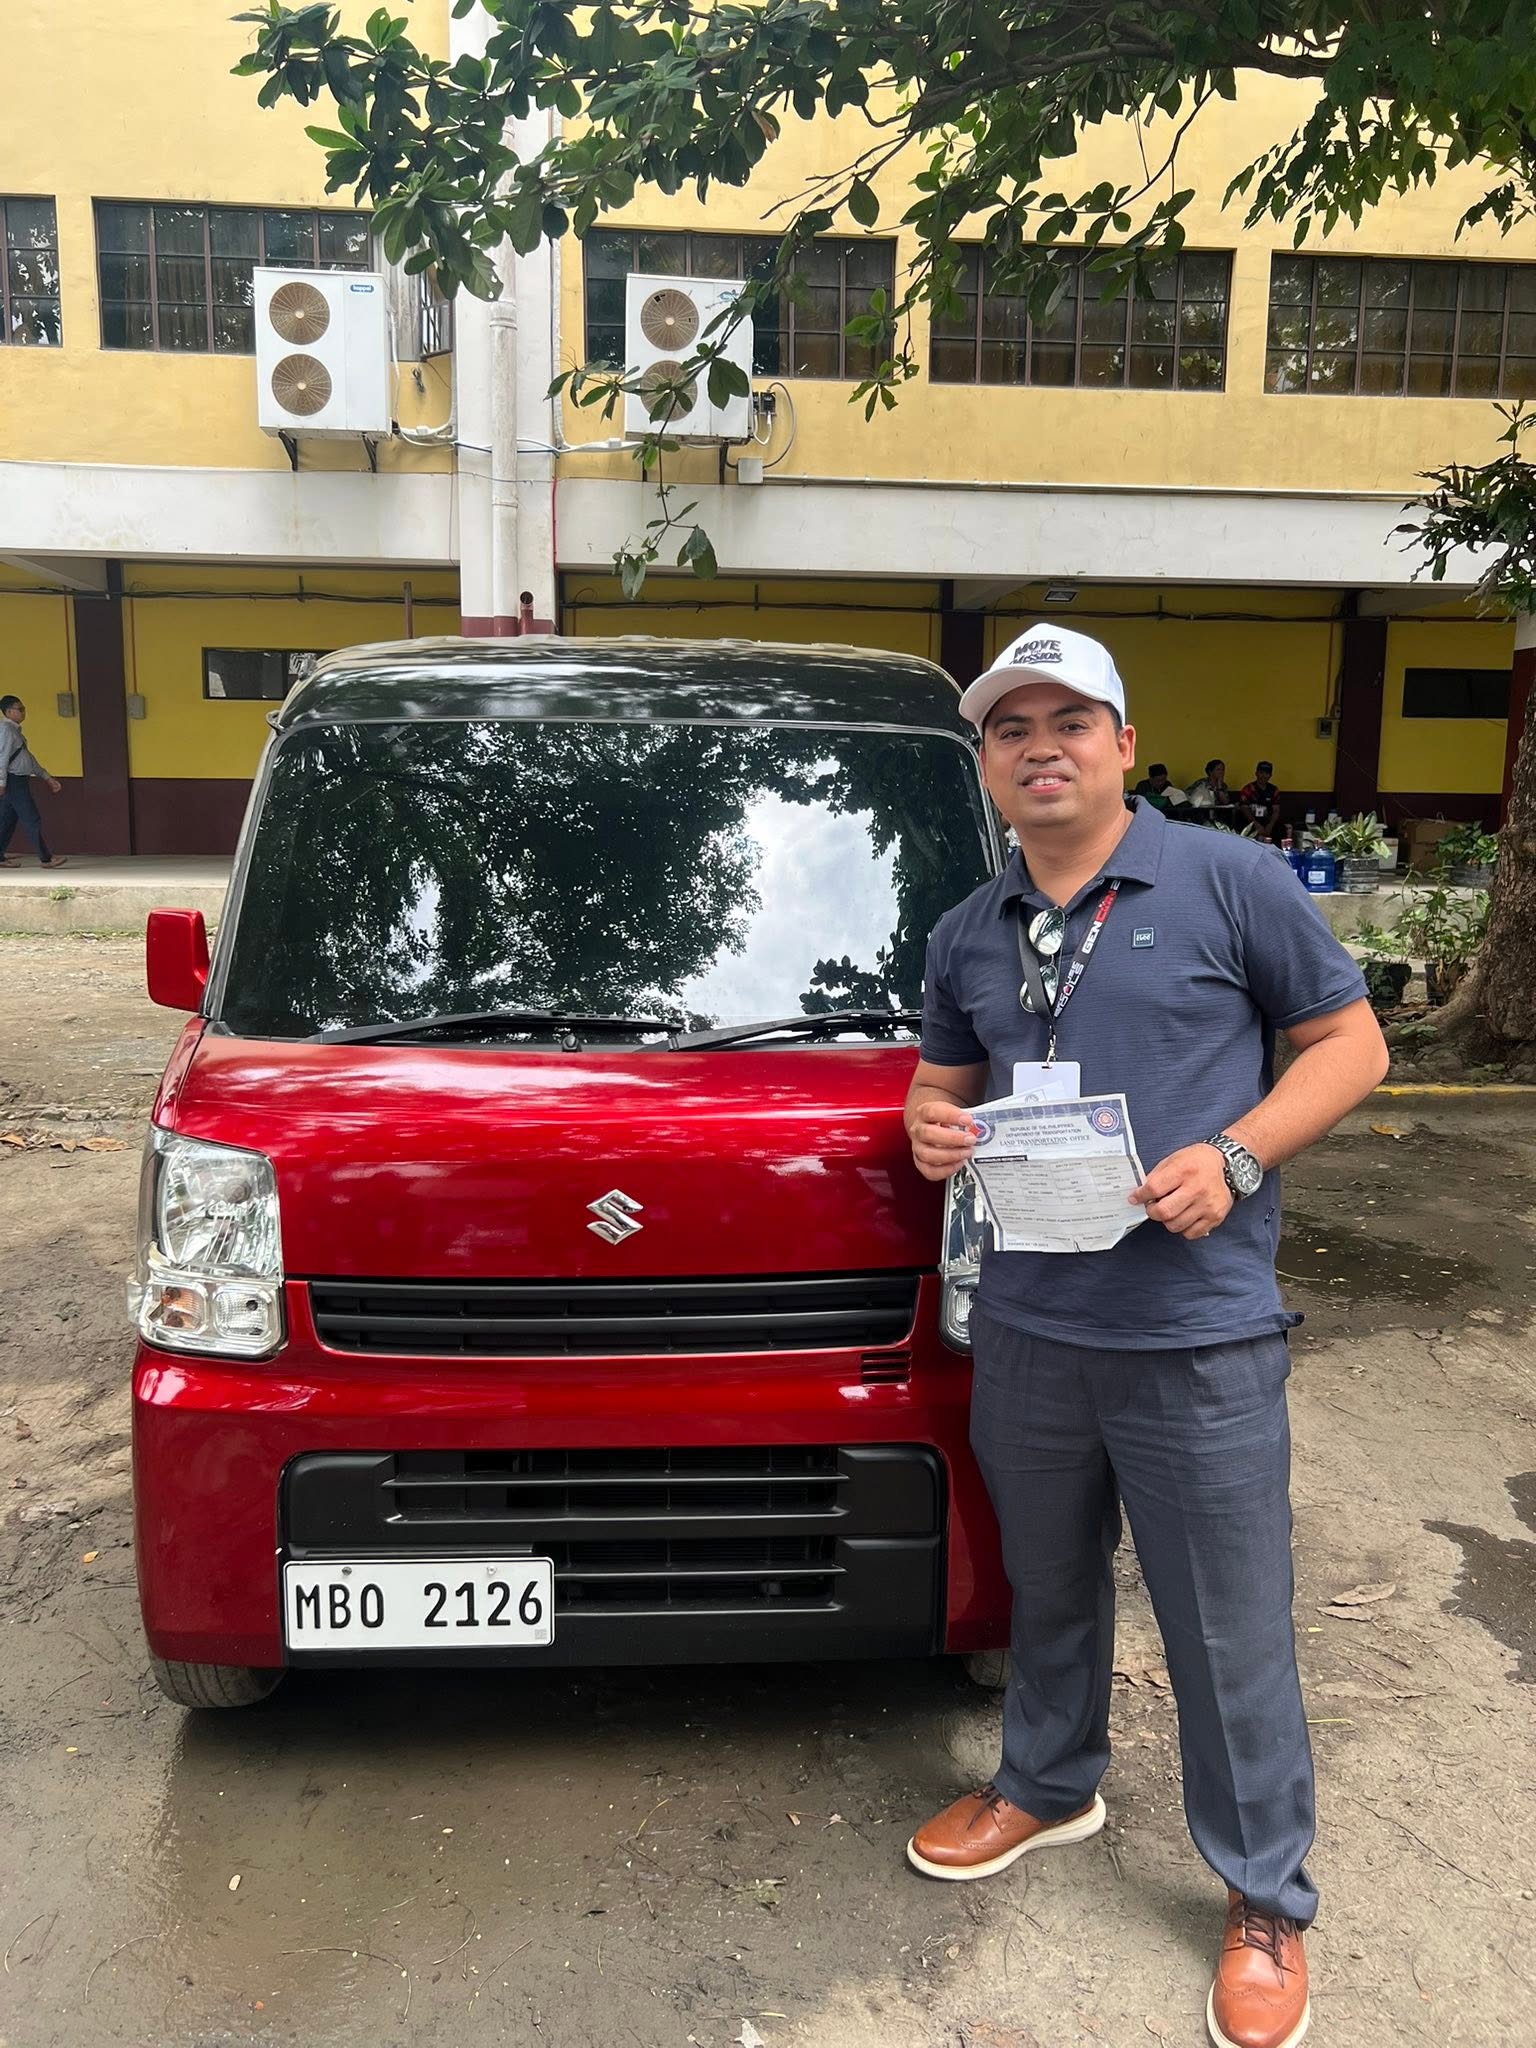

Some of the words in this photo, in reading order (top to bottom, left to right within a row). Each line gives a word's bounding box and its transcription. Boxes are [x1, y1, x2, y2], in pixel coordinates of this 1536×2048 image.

[1014, 640, 1061, 659] MOVE
[1009, 652, 1062, 664] MISSION
[1017, 1136, 1069, 1146] TRANSPORTATION
[295, 1583, 384, 1629] MBO
[424, 1581, 543, 1627] 2126
